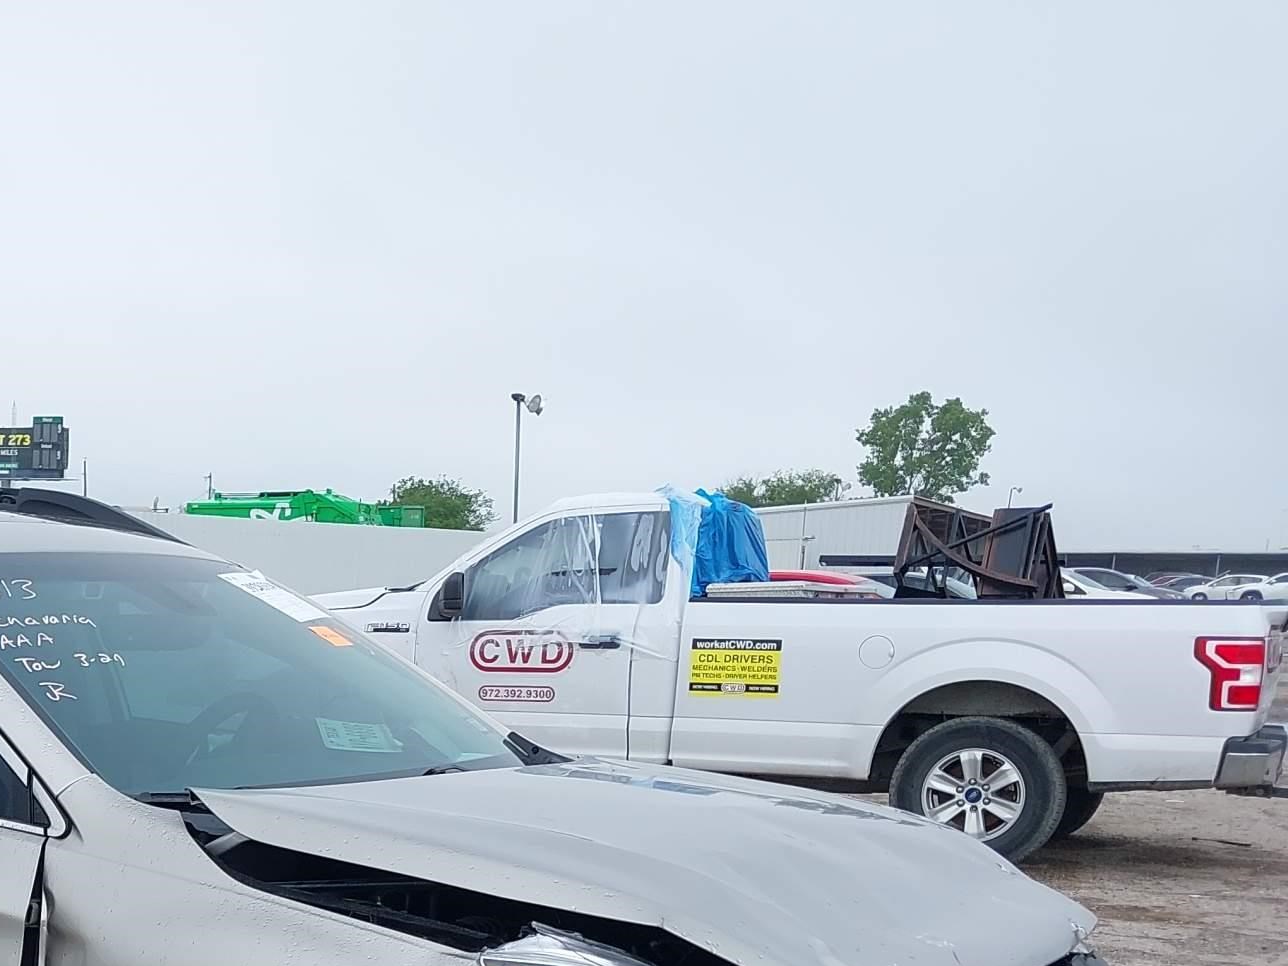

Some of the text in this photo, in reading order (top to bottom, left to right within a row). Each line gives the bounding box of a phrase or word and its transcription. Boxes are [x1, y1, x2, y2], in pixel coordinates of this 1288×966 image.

[8, 434, 31, 446] 273
[0, 632, 54, 650] AAA
[696, 640, 777, 650] workatCWD.com
[478, 638, 564, 664] CWD
[698, 653, 774, 664] CDL DRIVERS
[692, 664, 778, 673] MECHANICS WELDERS
[481, 688, 552, 699] 972.392.9300
